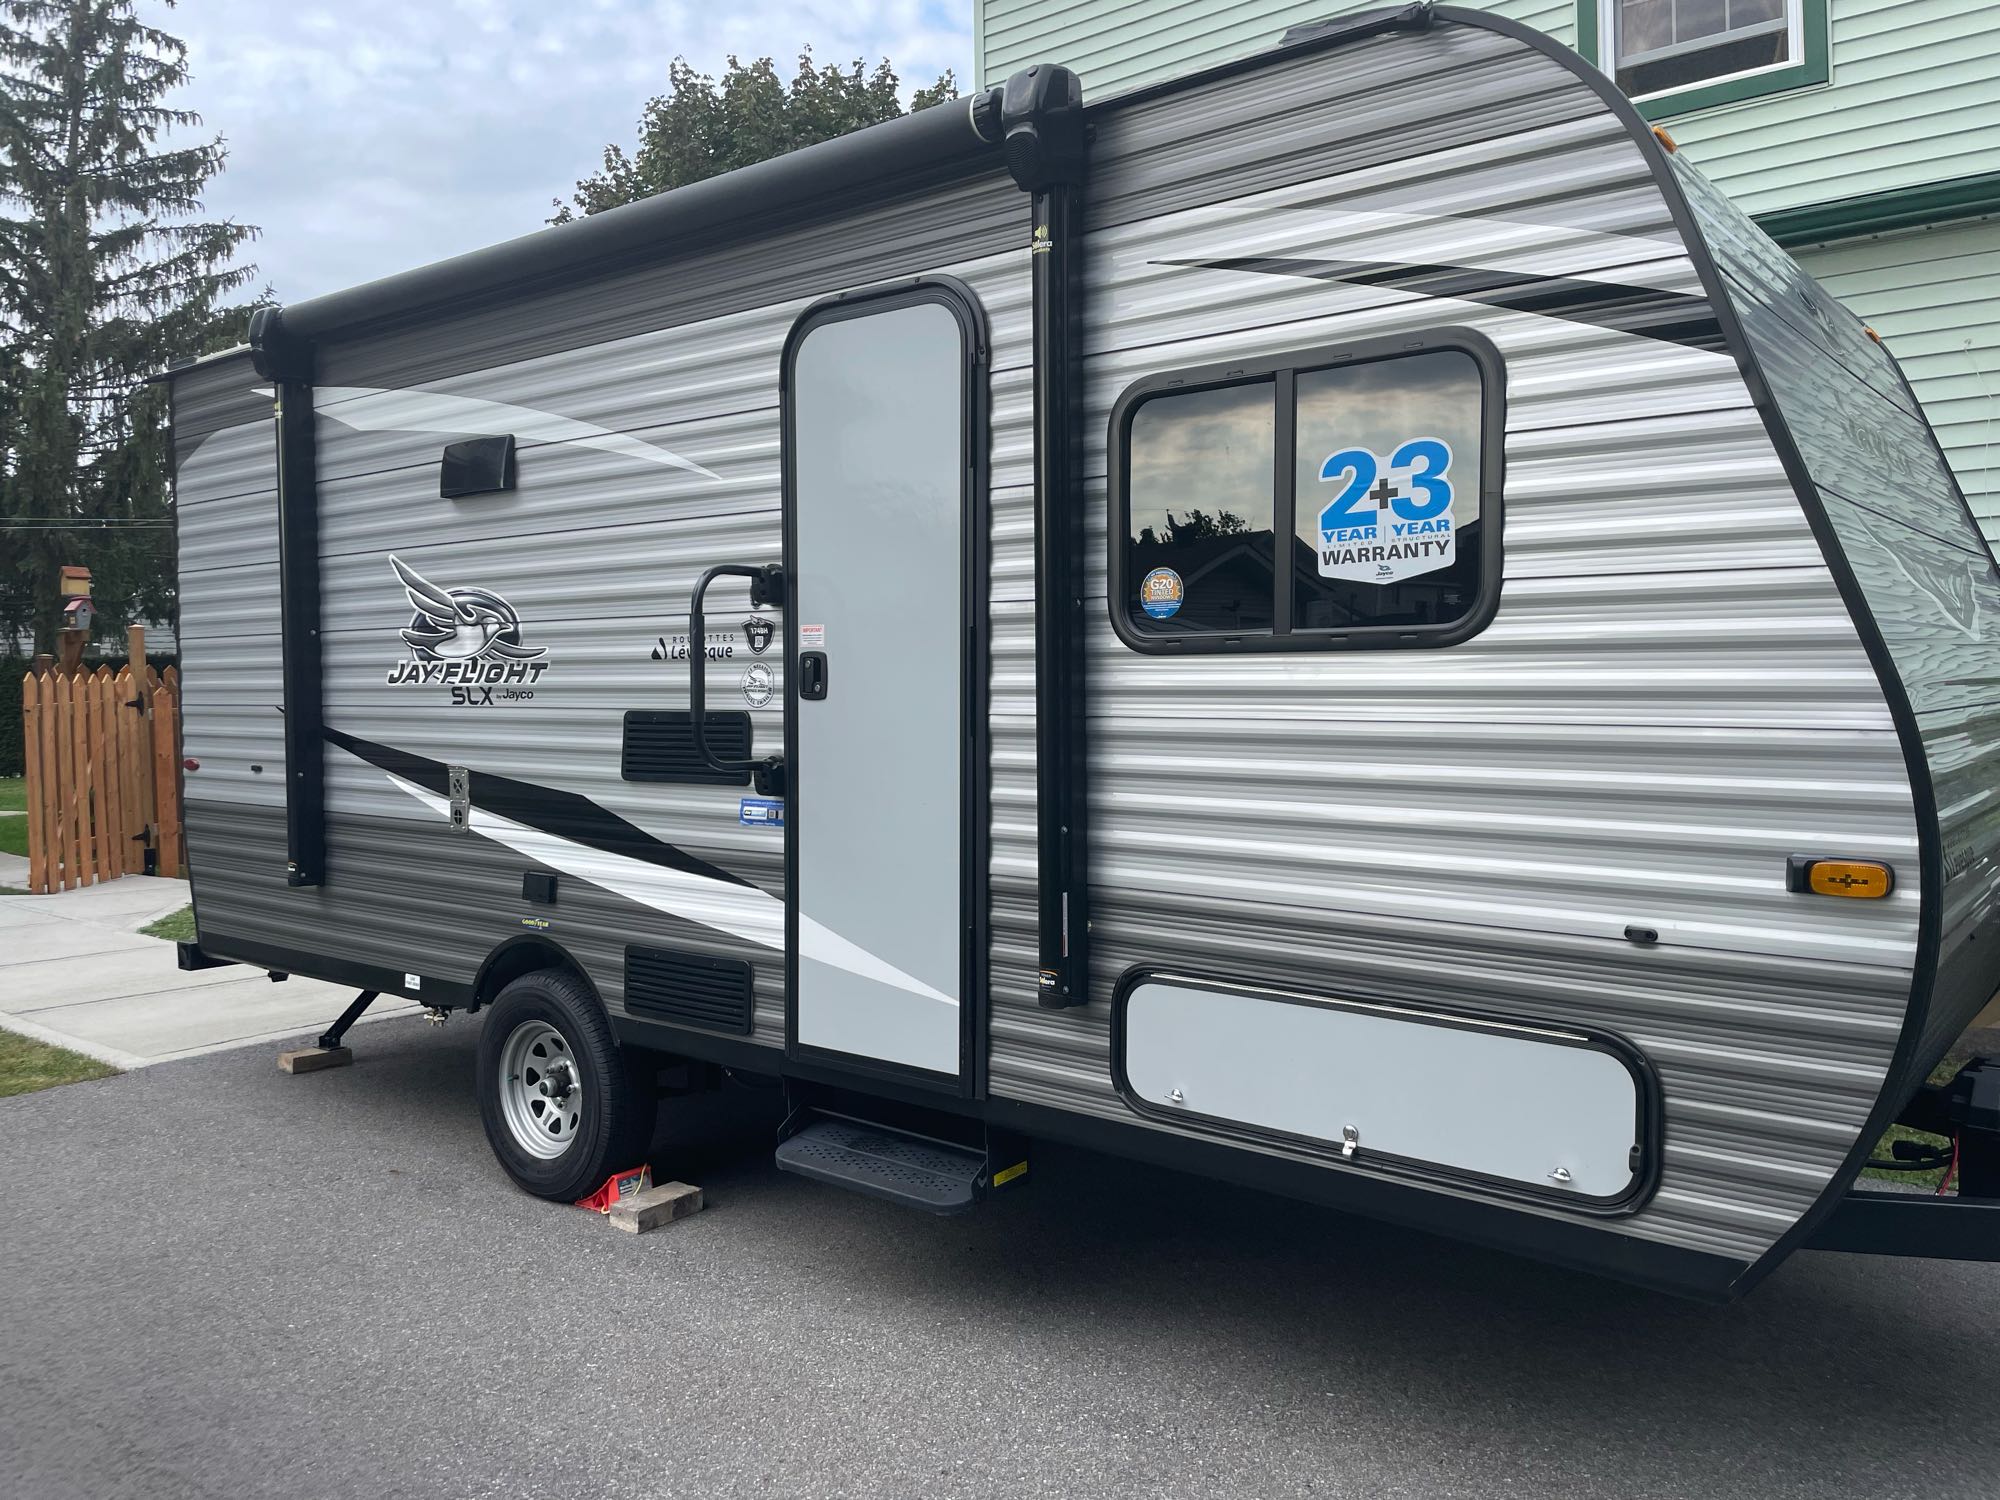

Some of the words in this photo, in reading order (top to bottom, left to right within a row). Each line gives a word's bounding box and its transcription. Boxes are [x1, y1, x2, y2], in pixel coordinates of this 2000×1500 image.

[1322, 527, 1377, 543] YEAR
[1391, 519, 1450, 536] YEAR
[1327, 541, 1373, 549] LIMITED
[1391, 533, 1451, 542] STRUCTURAL
[1322, 539, 1451, 566] WARRANTY
[1151, 579, 1174, 590] G20
[451, 686, 495, 706] SLX
[502, 688, 534, 701] Jayco
